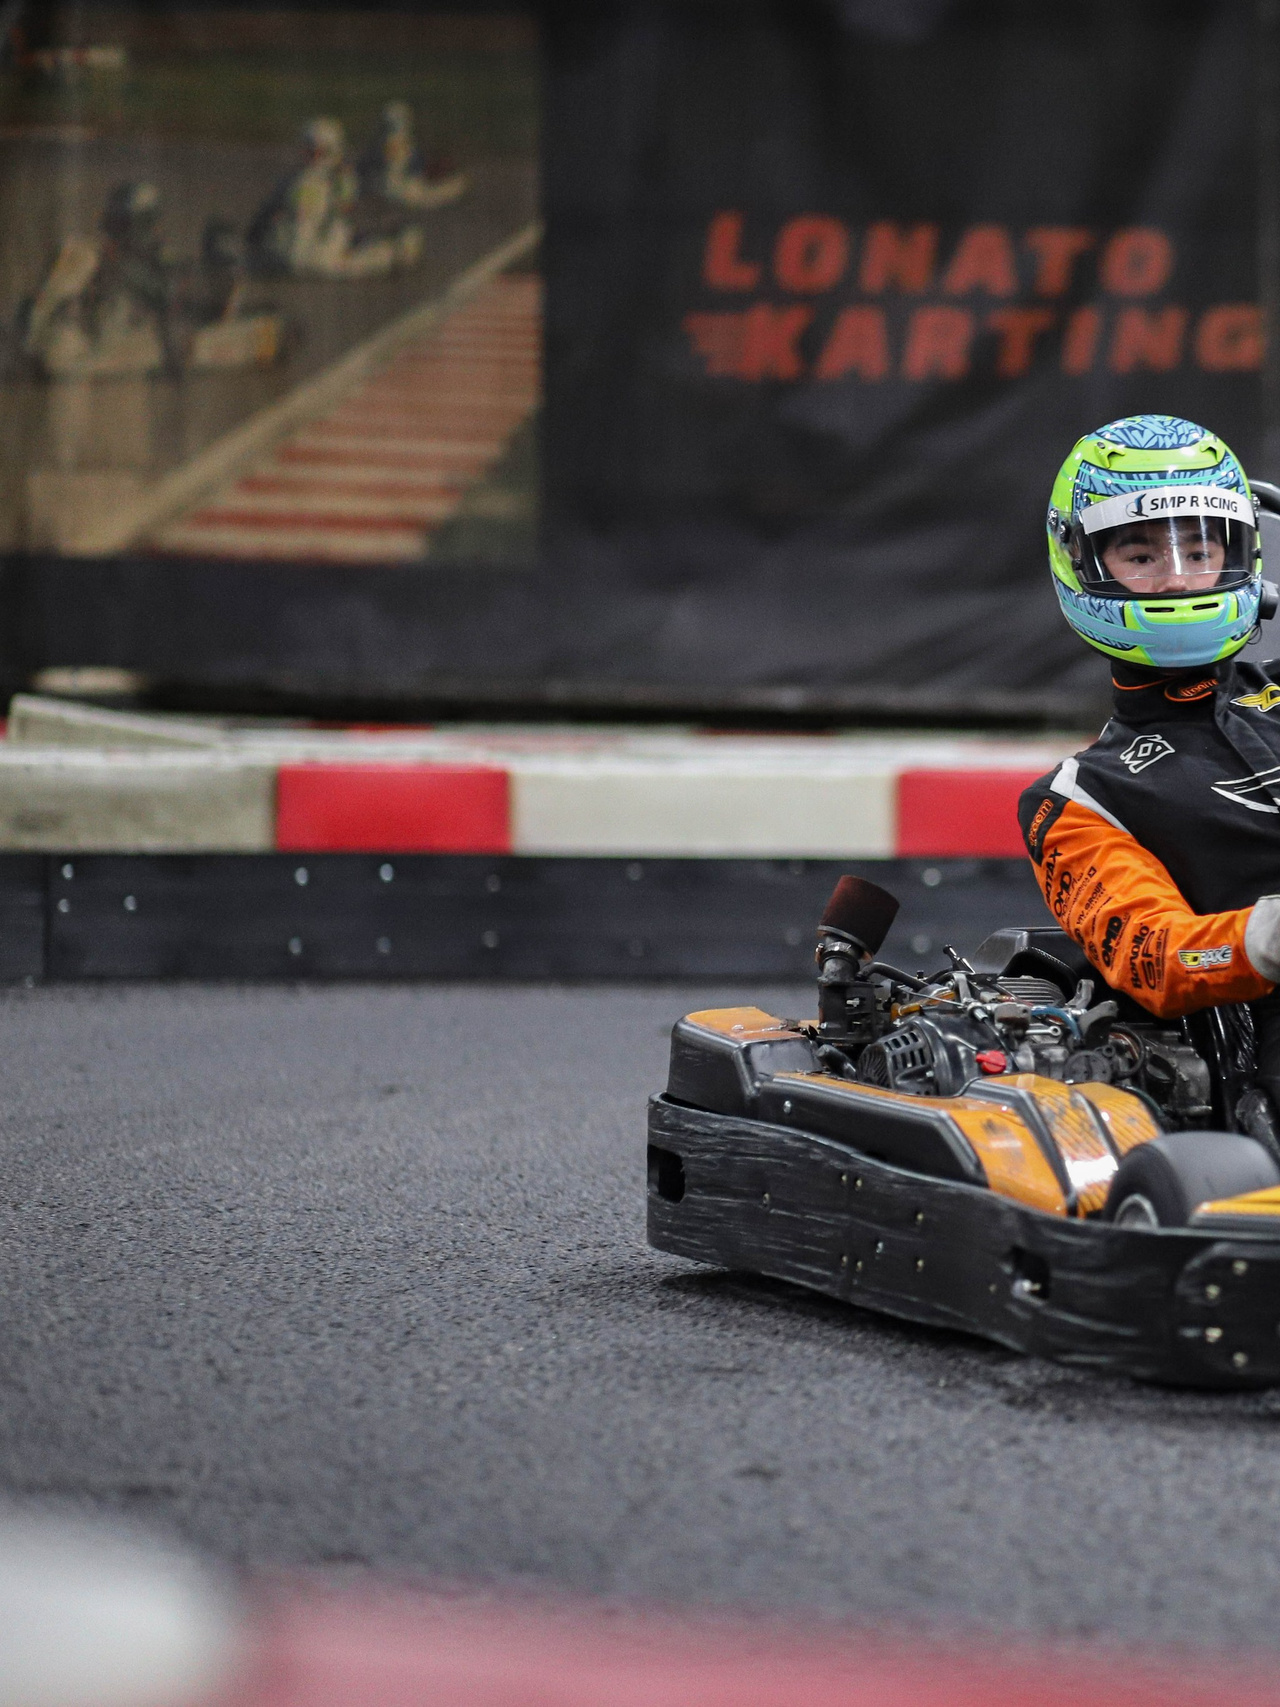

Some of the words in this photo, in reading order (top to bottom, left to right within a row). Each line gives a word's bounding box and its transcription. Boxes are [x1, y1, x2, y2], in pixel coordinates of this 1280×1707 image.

[703, 210, 1174, 298] LONATO
[738, 302, 1265, 384] KARTING
[1150, 495, 1187, 511] SMP
[1190, 495, 1238, 513] RACING
